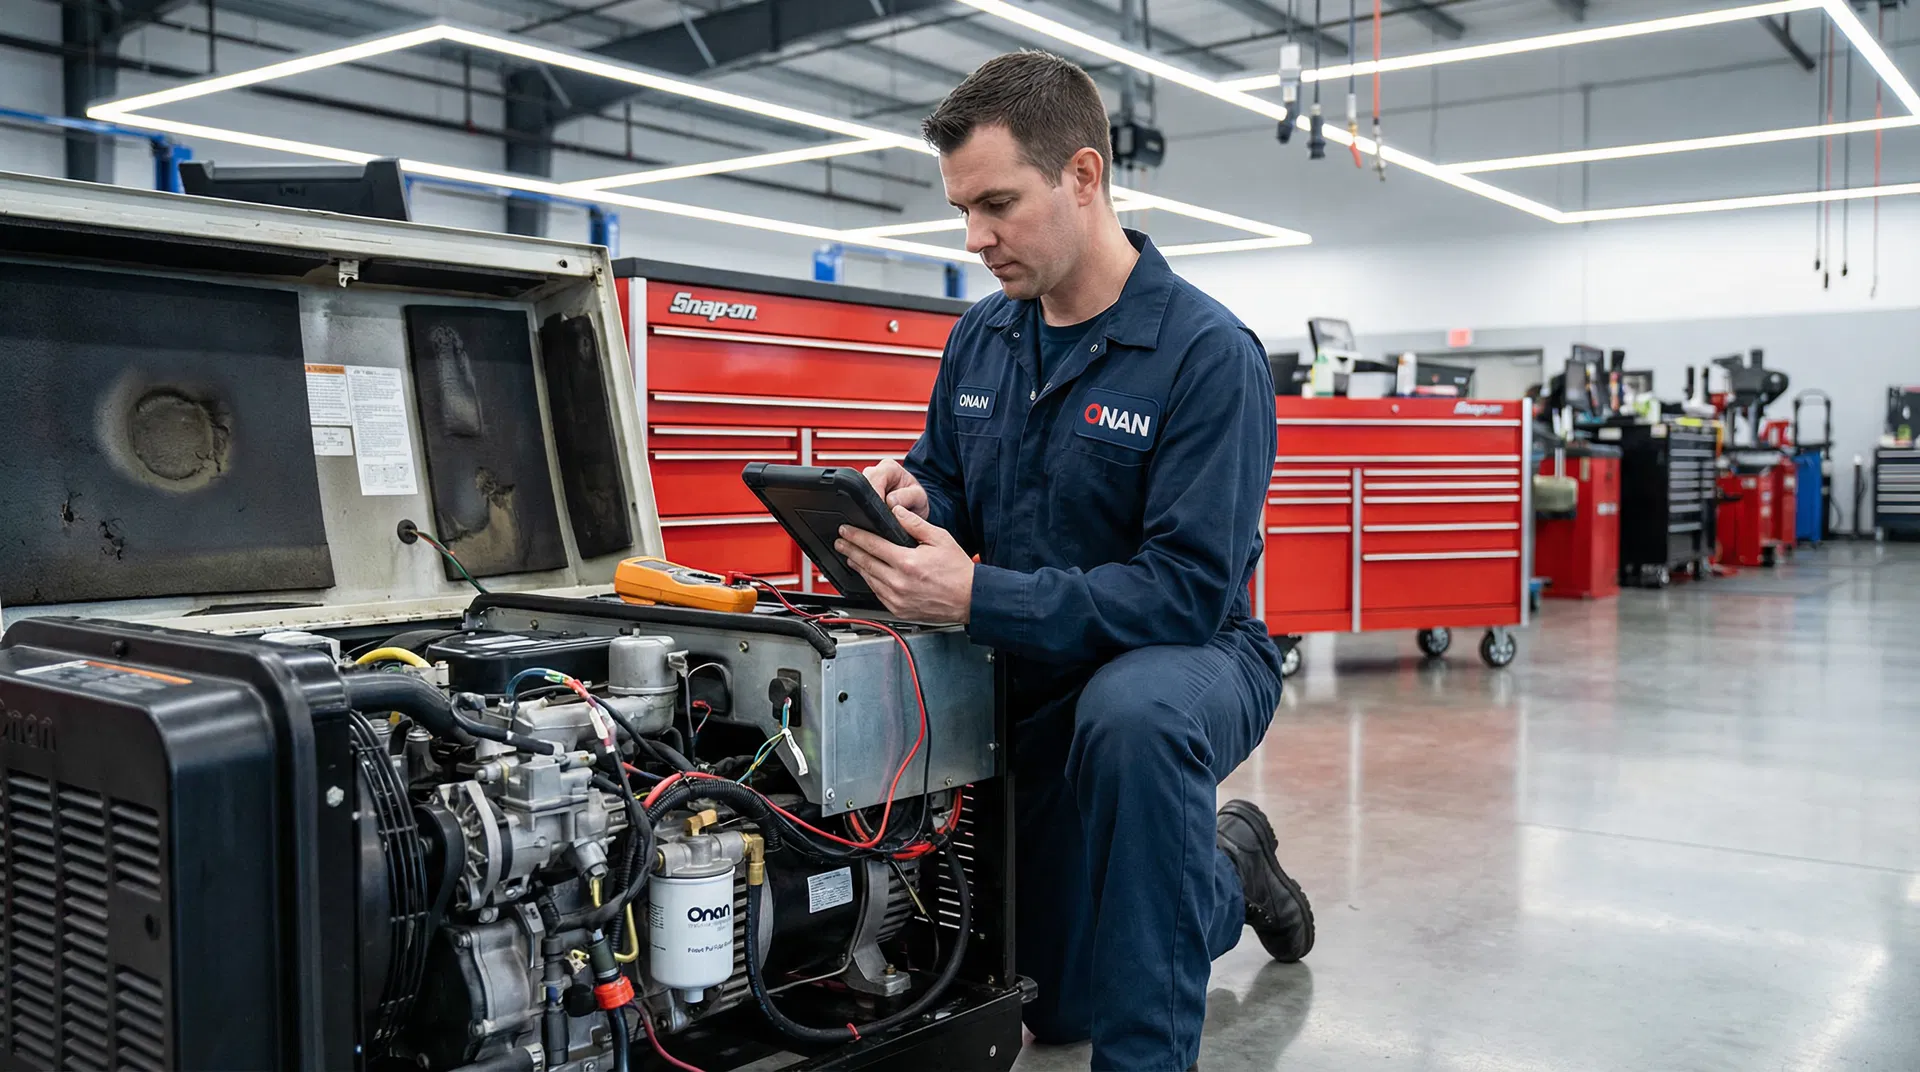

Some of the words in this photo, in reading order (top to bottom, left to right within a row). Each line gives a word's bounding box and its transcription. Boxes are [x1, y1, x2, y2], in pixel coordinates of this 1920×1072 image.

[669, 291, 757, 322] Snap-on
[959, 393, 990, 410] ONAN
[1084, 403, 1151, 437] ONAN
[0, 697, 57, 753] nan
[687, 903, 731, 923] Onan
